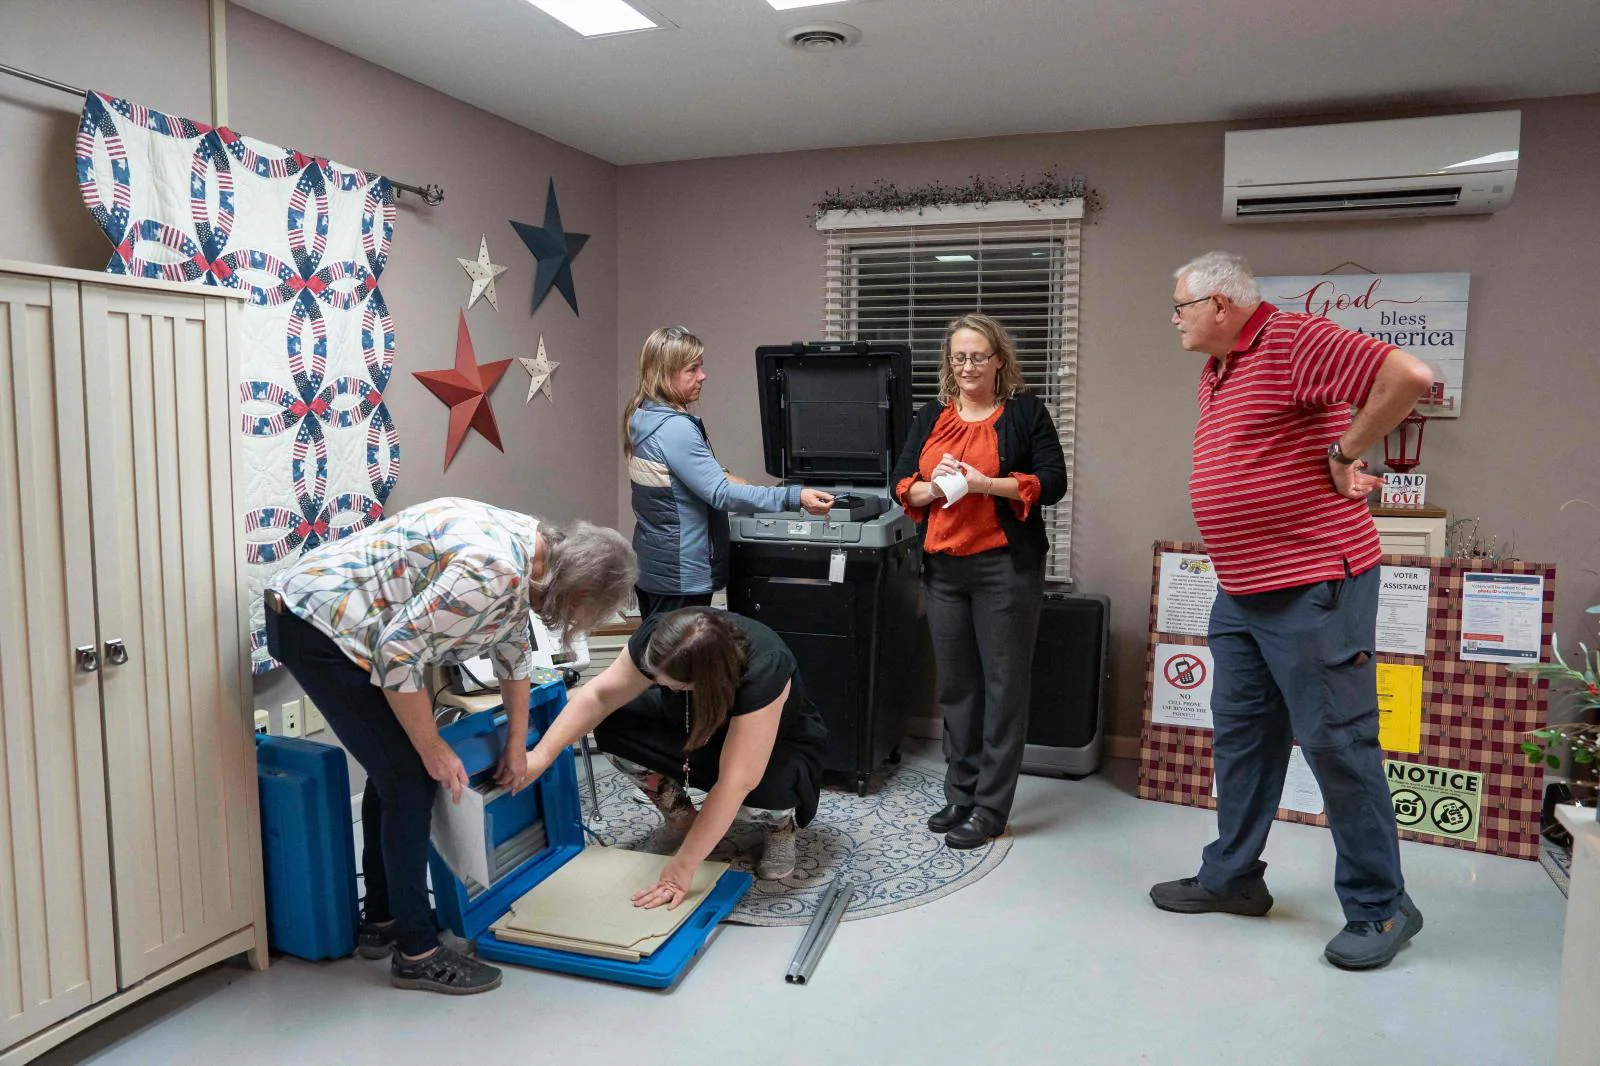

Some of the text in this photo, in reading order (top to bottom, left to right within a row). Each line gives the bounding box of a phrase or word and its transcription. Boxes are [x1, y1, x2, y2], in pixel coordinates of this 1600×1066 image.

[1278, 278, 1423, 317] God
[1381, 311, 1427, 326] bless
[1357, 326, 1455, 347] merica
[1384, 474, 1424, 486] LAND
[1383, 492, 1422, 504] LOVE
[1383, 582, 1428, 591] ASSISTANCE
[1388, 764, 1478, 792] NOTICE
